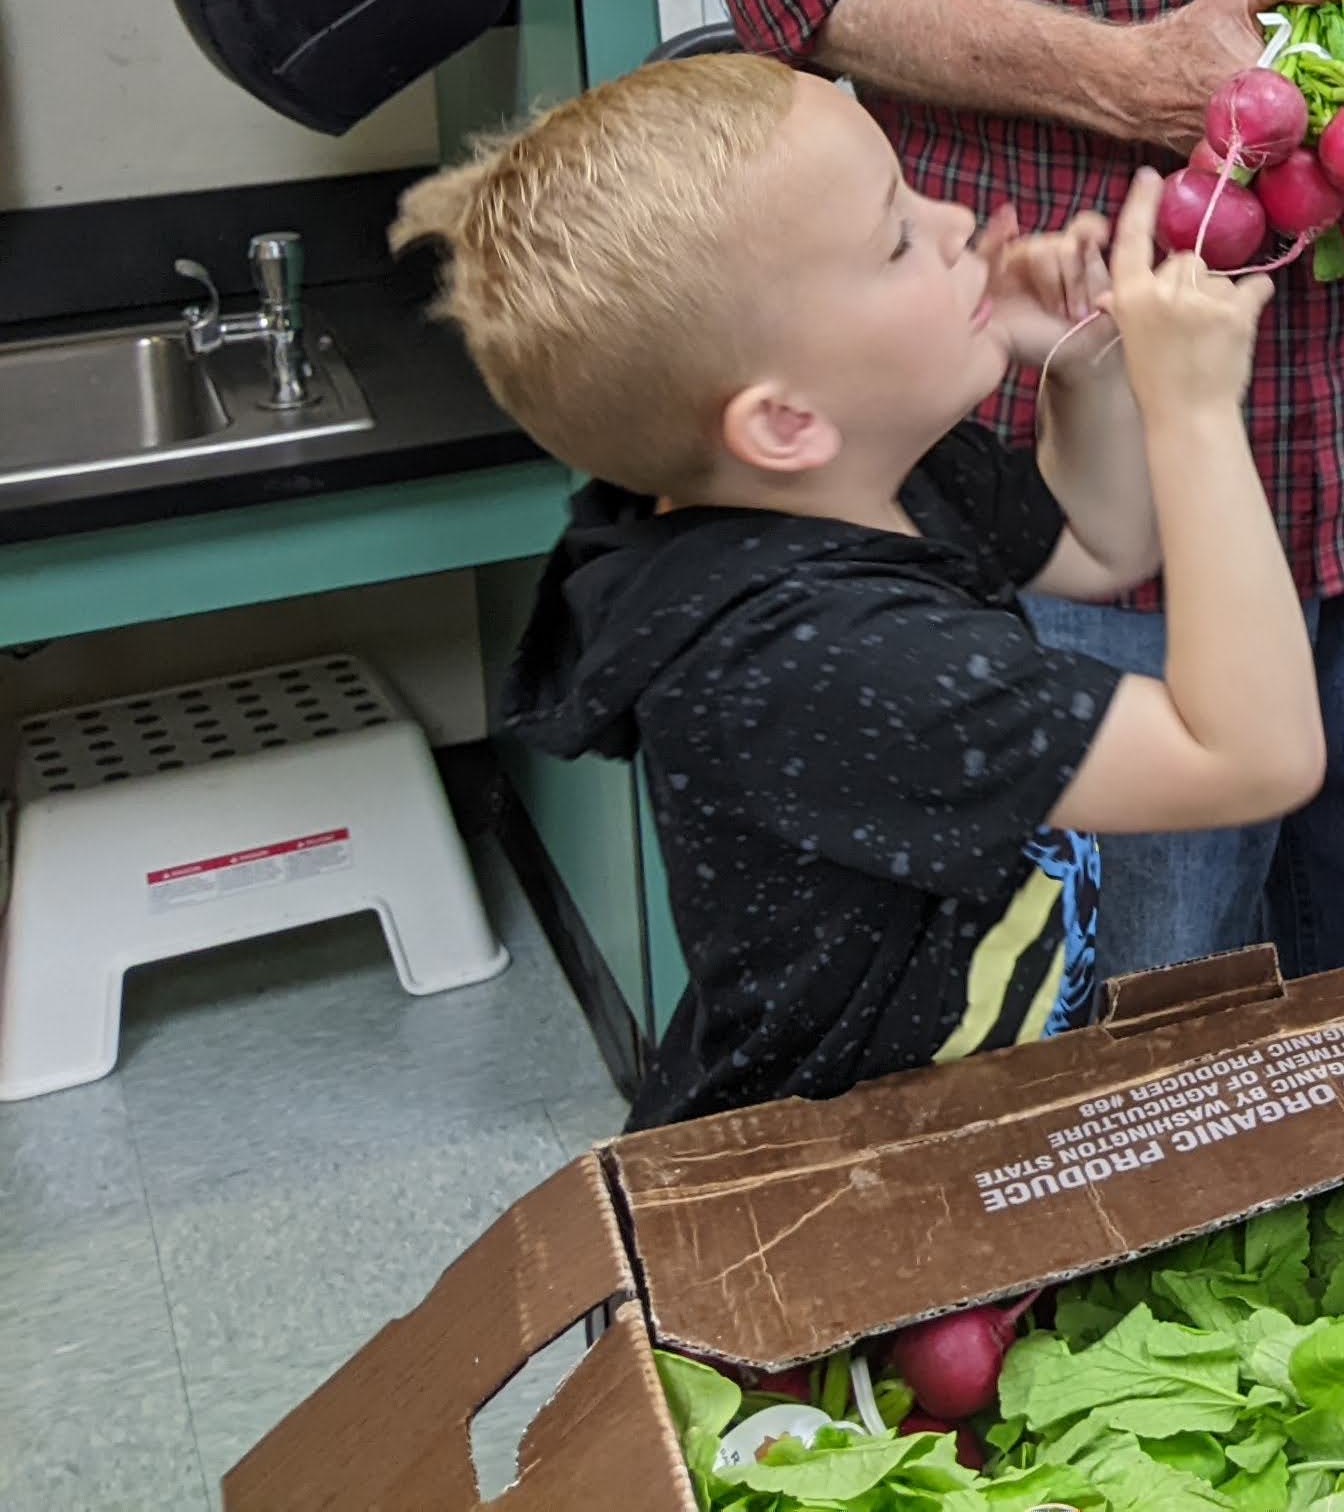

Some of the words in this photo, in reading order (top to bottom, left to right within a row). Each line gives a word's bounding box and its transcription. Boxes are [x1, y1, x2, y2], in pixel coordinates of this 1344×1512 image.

[1129, 1051, 1264, 1103] PRODUCER
[1226, 1070, 1259, 1091] OF
[1235, 1086, 1268, 1108] BY
[1047, 1084, 1220, 1149] AGRICULTURE
[1060, 1099, 1230, 1165] WASHINGTON
[1078, 1094, 1124, 1119] #68
[1171, 1082, 1339, 1153] ORGANIC
[974, 1154, 1055, 1188] STATE
[980, 1140, 1166, 1213] PRODUCE
